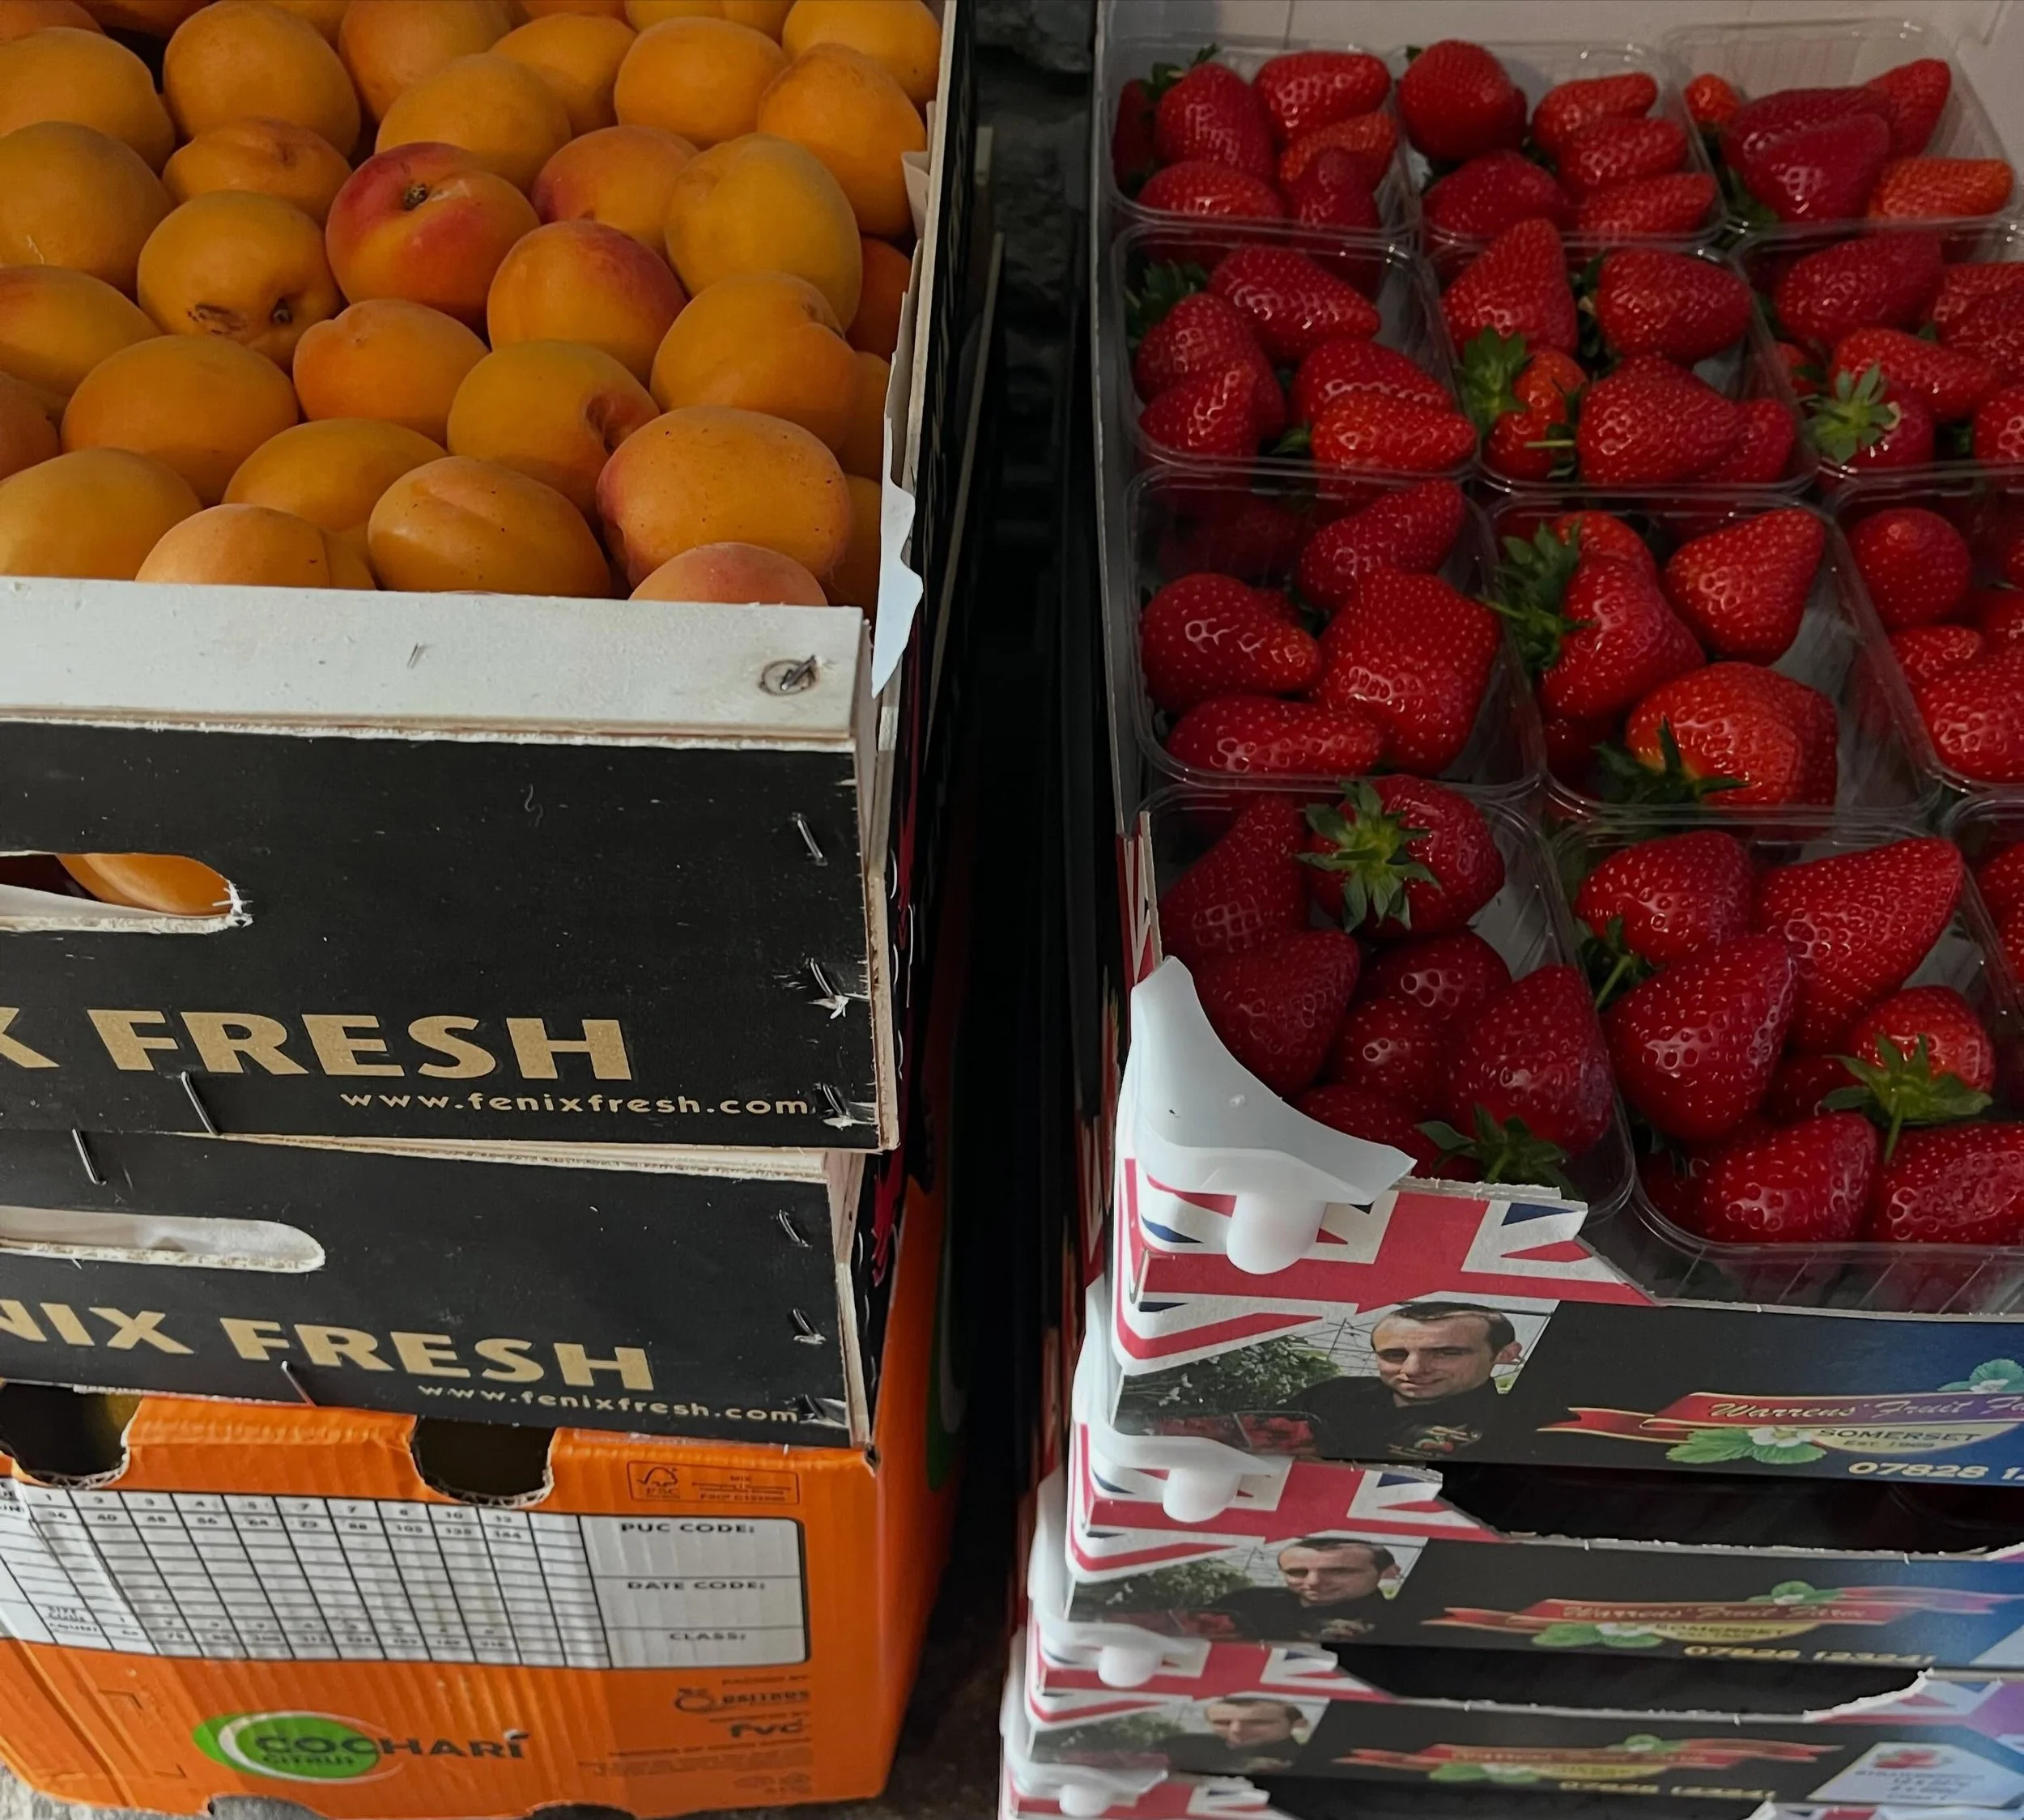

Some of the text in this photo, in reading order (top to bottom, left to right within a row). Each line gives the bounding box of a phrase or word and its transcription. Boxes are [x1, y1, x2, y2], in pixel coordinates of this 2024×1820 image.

[87, 1009, 632, 1080] FRESH
[340, 1091, 809, 1115] www.fenixfresh.com
[219, 1317, 654, 1392] FRESH
[418, 1384, 798, 1422] www.fenixfresh.com
[1871, 1400, 1973, 1419] Fruit
[1820, 1429, 1982, 1442] SOMERSET
[1848, 1462, 1989, 1479] 07828
[620, 1523, 755, 1533] PUC CODE:
[627, 1581, 765, 1590] DATE CODE:
[669, 1631, 746, 1641] CLASS:
